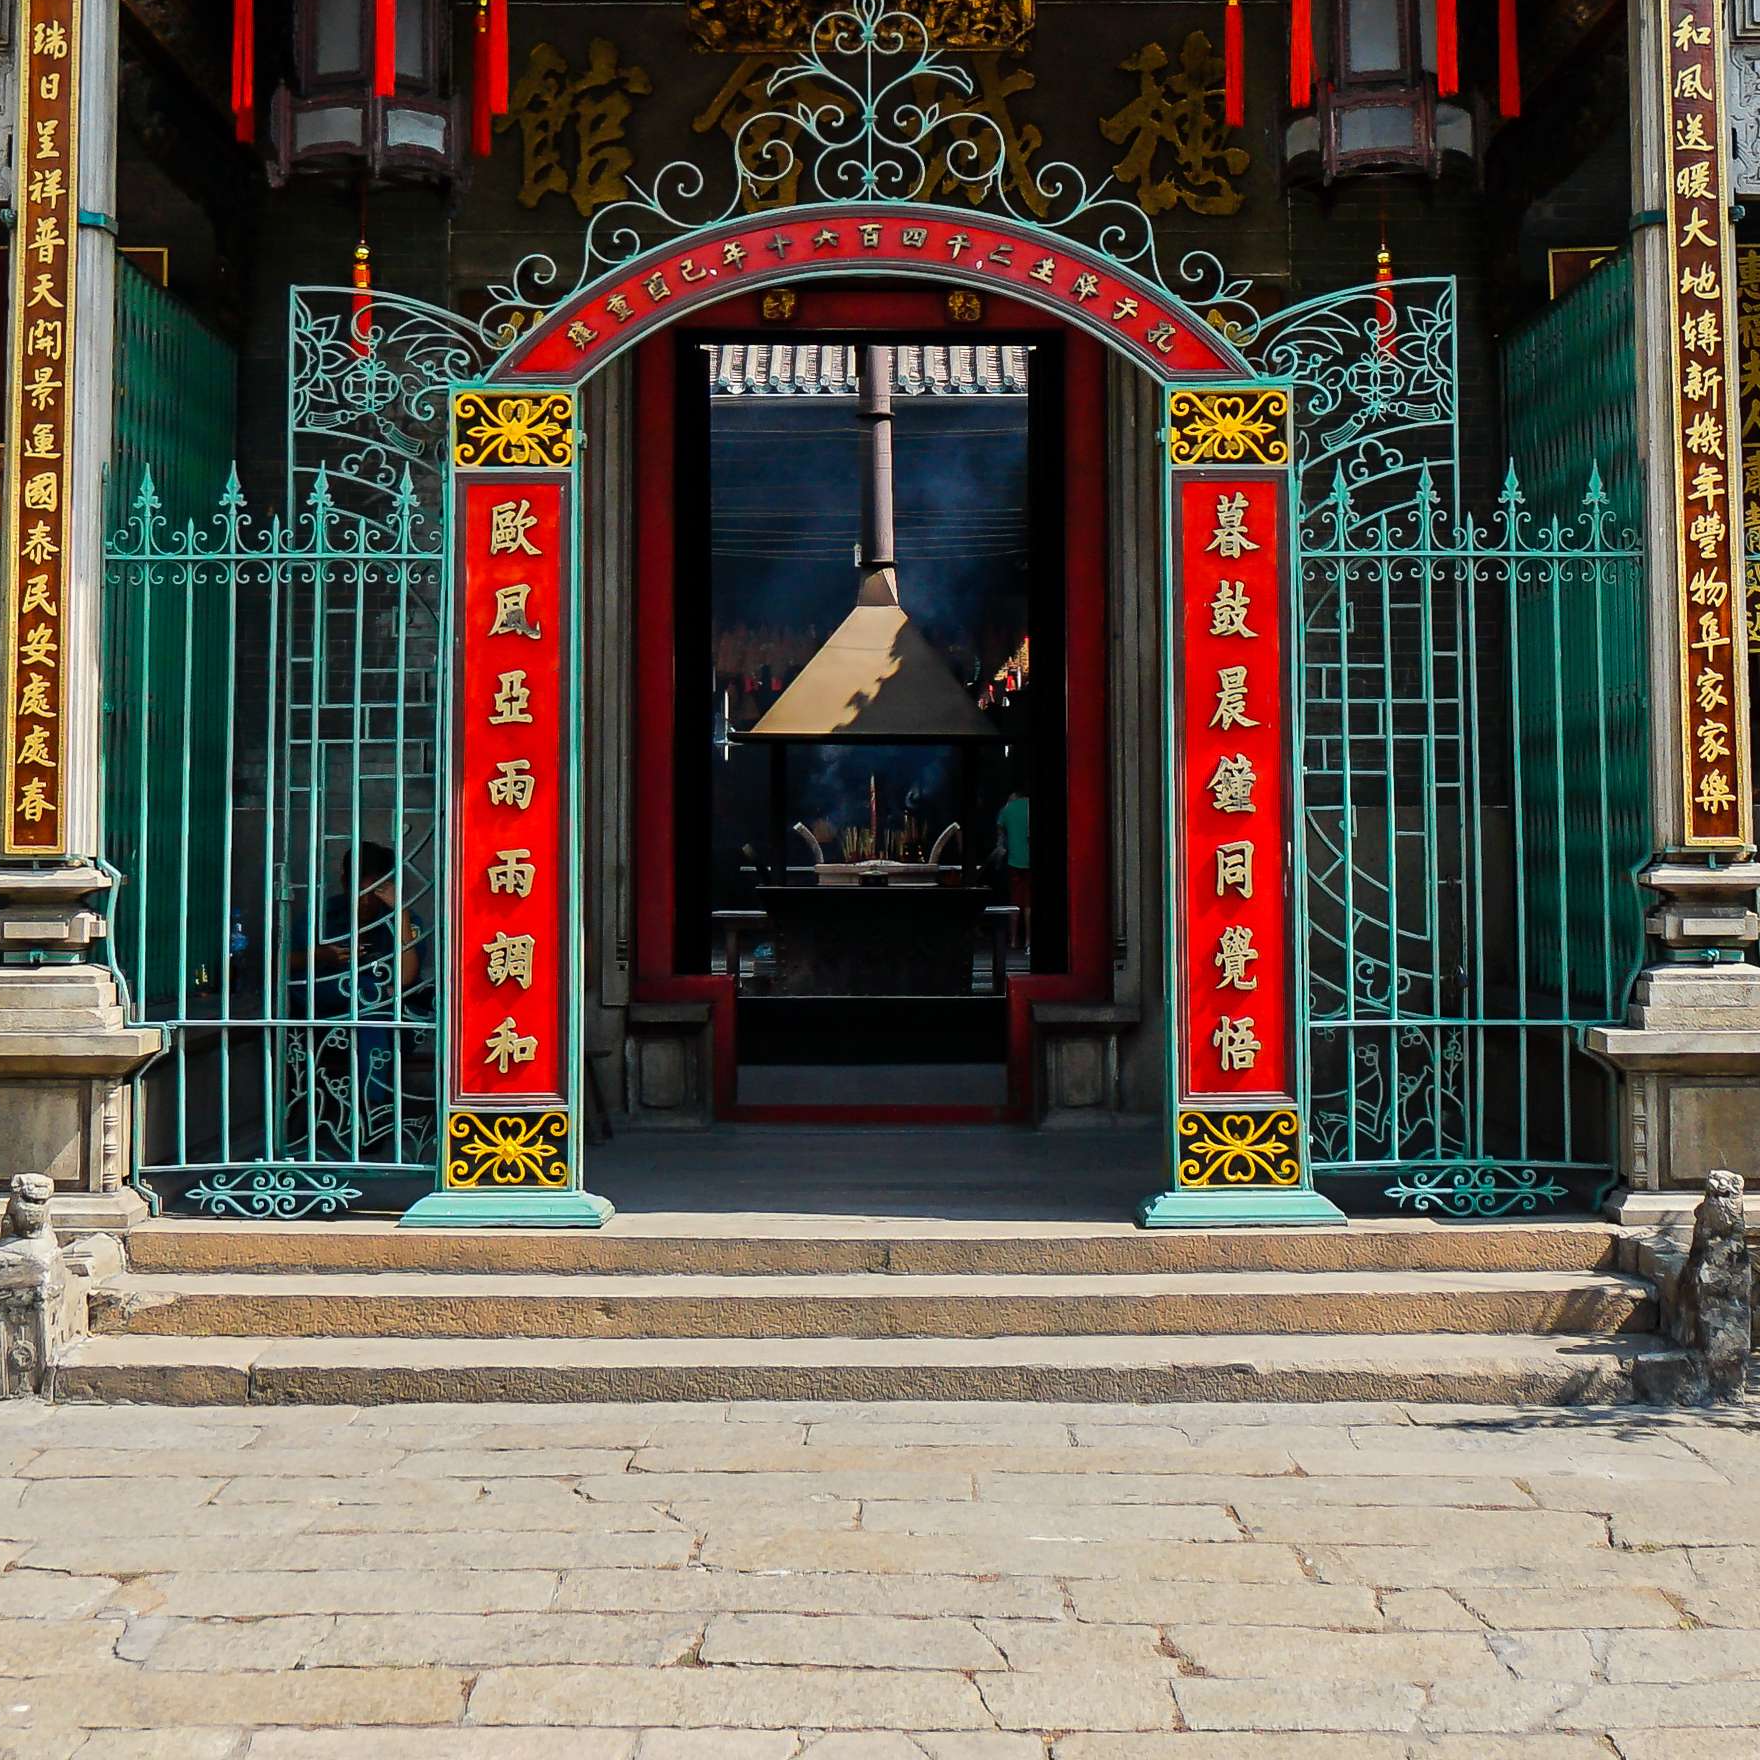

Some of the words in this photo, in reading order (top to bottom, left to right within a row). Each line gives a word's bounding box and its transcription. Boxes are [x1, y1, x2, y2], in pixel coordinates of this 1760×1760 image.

[1205, 492, 1262, 1072] 暮鼓晨鐘同覺悟
